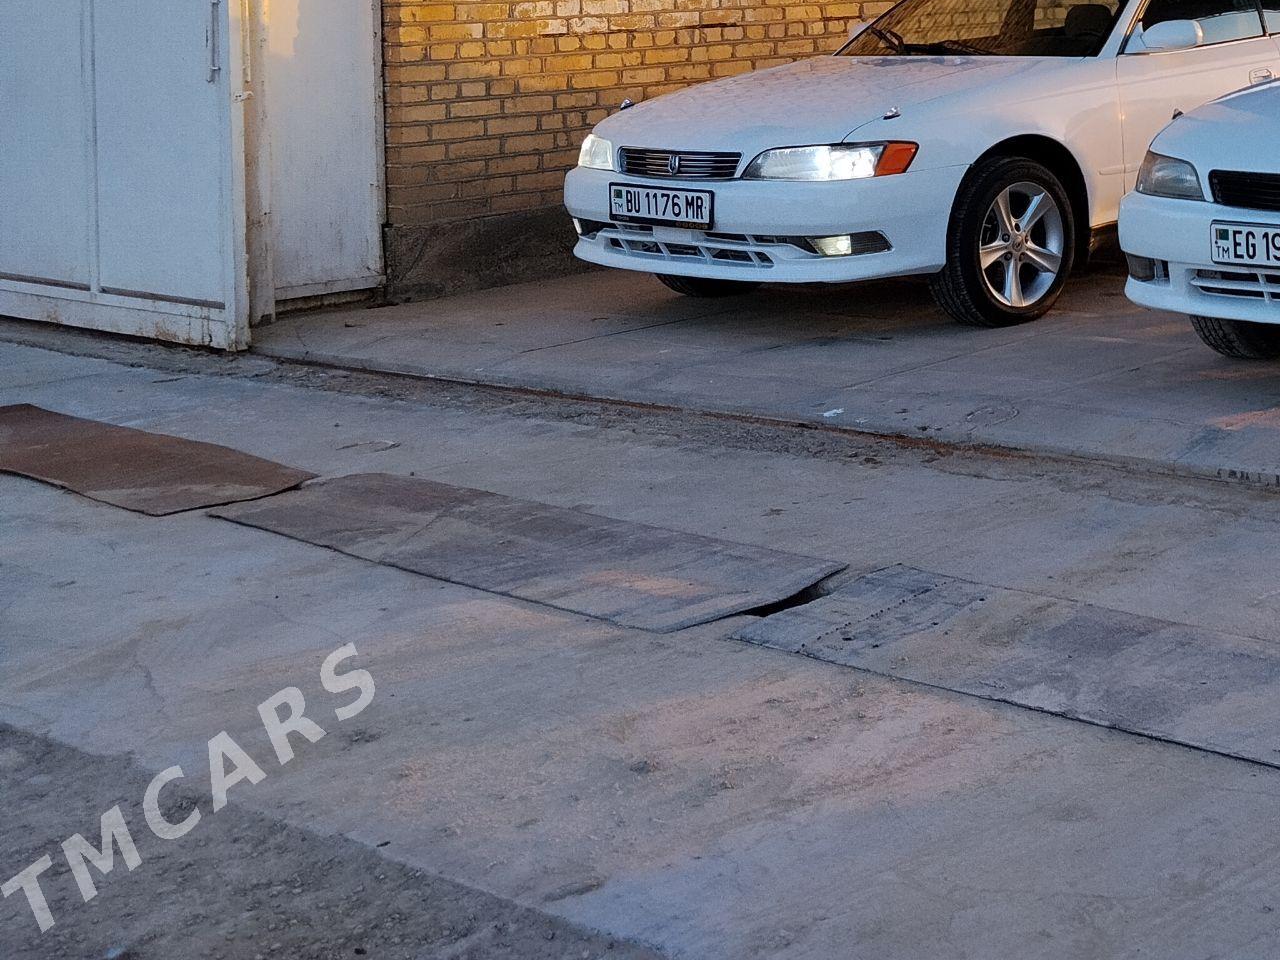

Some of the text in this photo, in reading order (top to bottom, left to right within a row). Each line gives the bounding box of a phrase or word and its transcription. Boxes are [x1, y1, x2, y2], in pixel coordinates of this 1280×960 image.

[614, 190, 704, 219] TM BU 1176 MR
[1215, 245, 1230, 259] TM
[1232, 230, 1256, 260] EG
